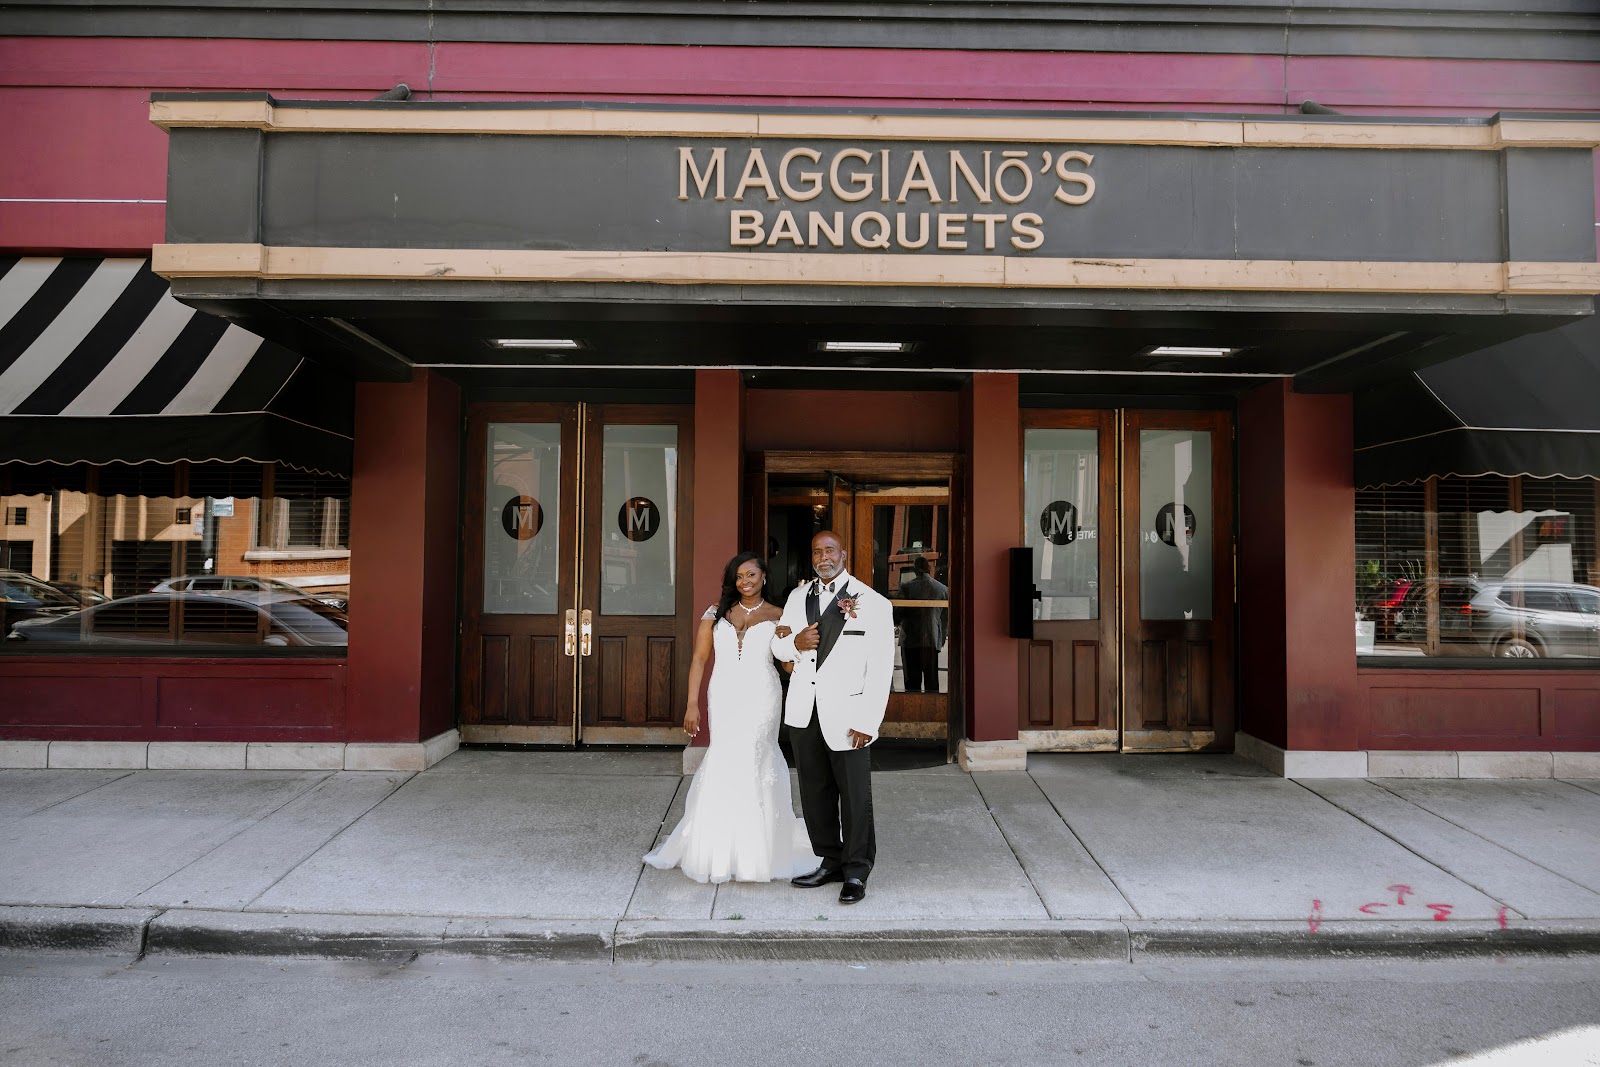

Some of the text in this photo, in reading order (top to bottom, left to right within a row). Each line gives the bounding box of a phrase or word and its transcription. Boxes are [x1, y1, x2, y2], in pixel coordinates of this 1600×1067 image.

[730, 209, 1045, 250] BANQUETS
[512, 505, 533, 530] M
[628, 507, 650, 532] M
[1050, 510, 1072, 535] M
